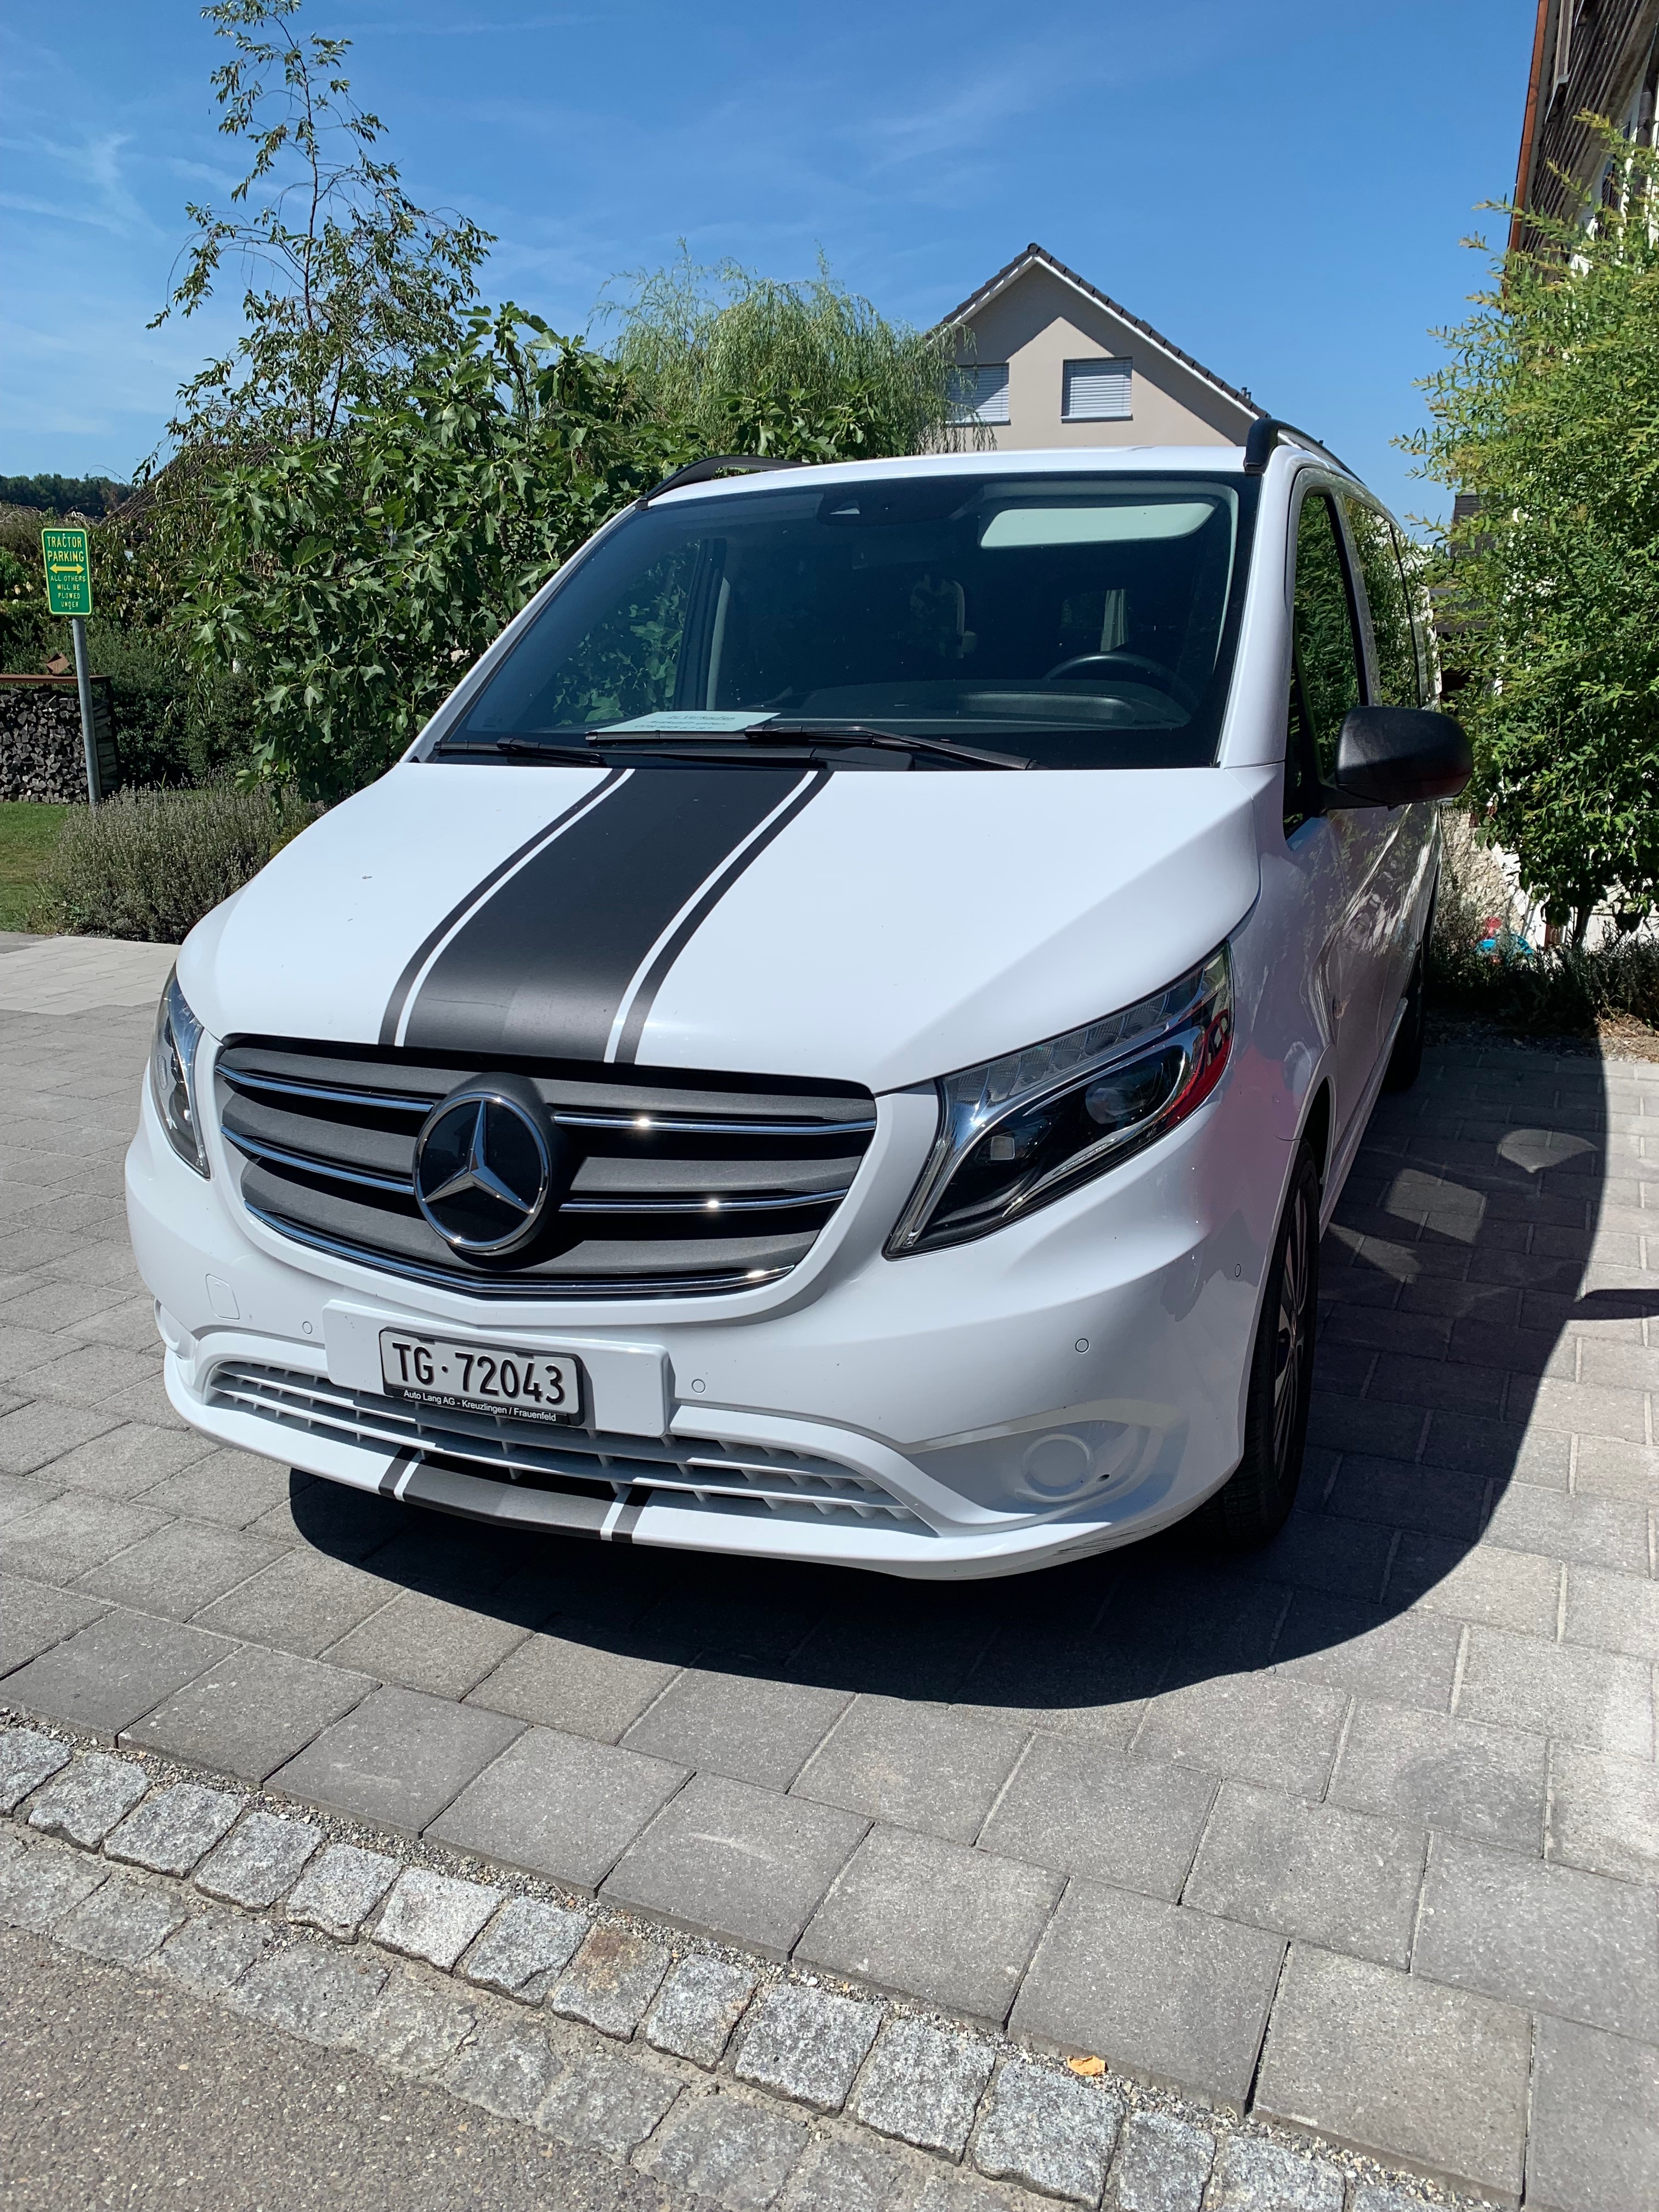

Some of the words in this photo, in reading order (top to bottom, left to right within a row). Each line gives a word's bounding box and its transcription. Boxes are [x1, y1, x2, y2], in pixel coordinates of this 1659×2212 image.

[47, 536, 82, 548] TRACTOR
[47, 550, 84, 562] PARKING
[404, 1390, 421, 1400] Auto
[422, 1392, 442, 1405] Lang
[443, 1397, 455, 1406] AG
[461, 1400, 507, 1414] Kreuzlingen
[514, 1408, 557, 1421] Frauenfeld
